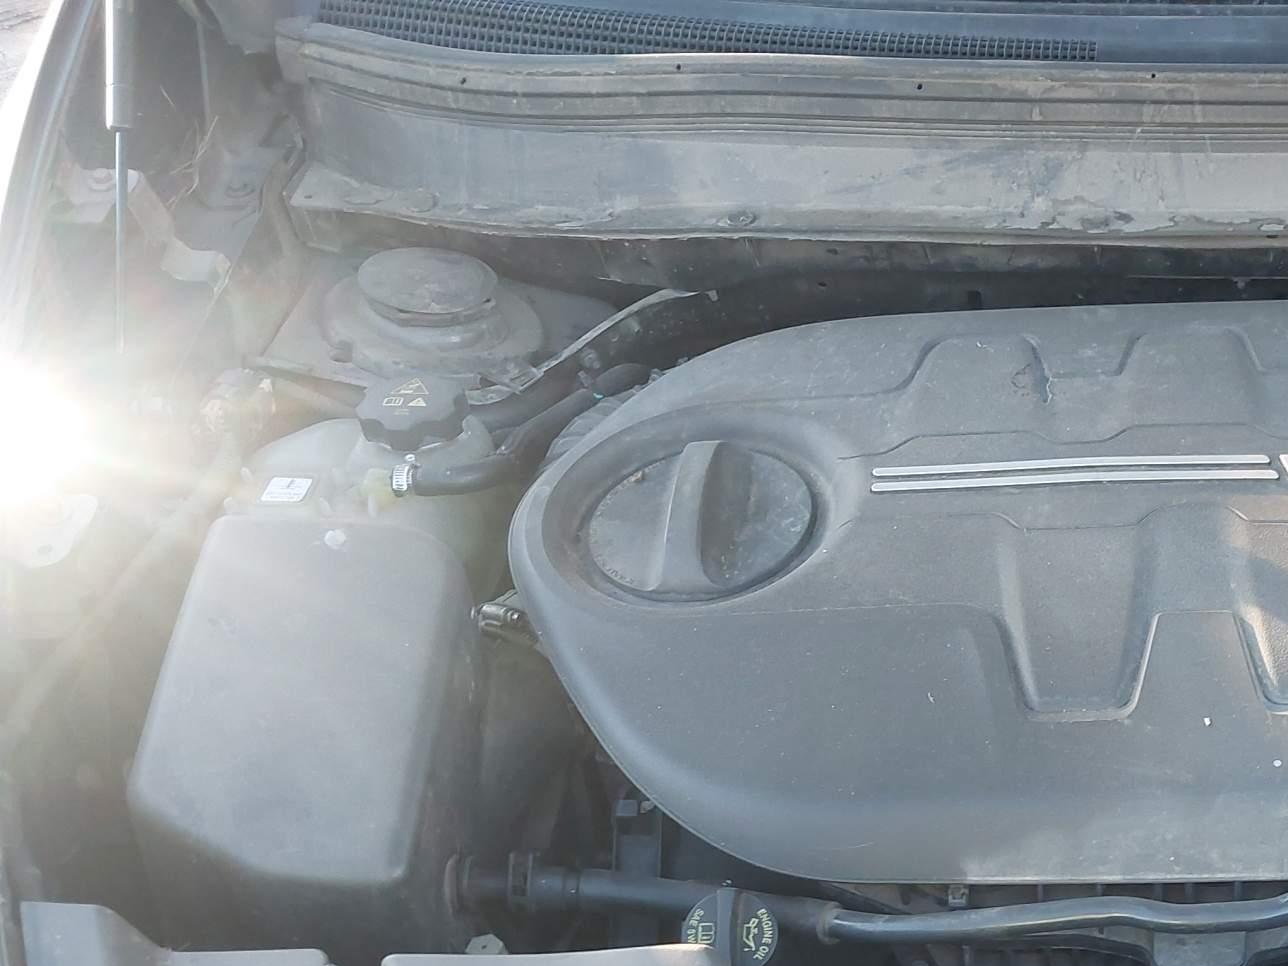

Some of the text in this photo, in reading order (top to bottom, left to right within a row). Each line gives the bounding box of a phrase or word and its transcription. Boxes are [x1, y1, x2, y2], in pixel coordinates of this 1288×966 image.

[688, 908, 705, 928] SAE
[753, 908, 773, 961] ENGINE OIL
